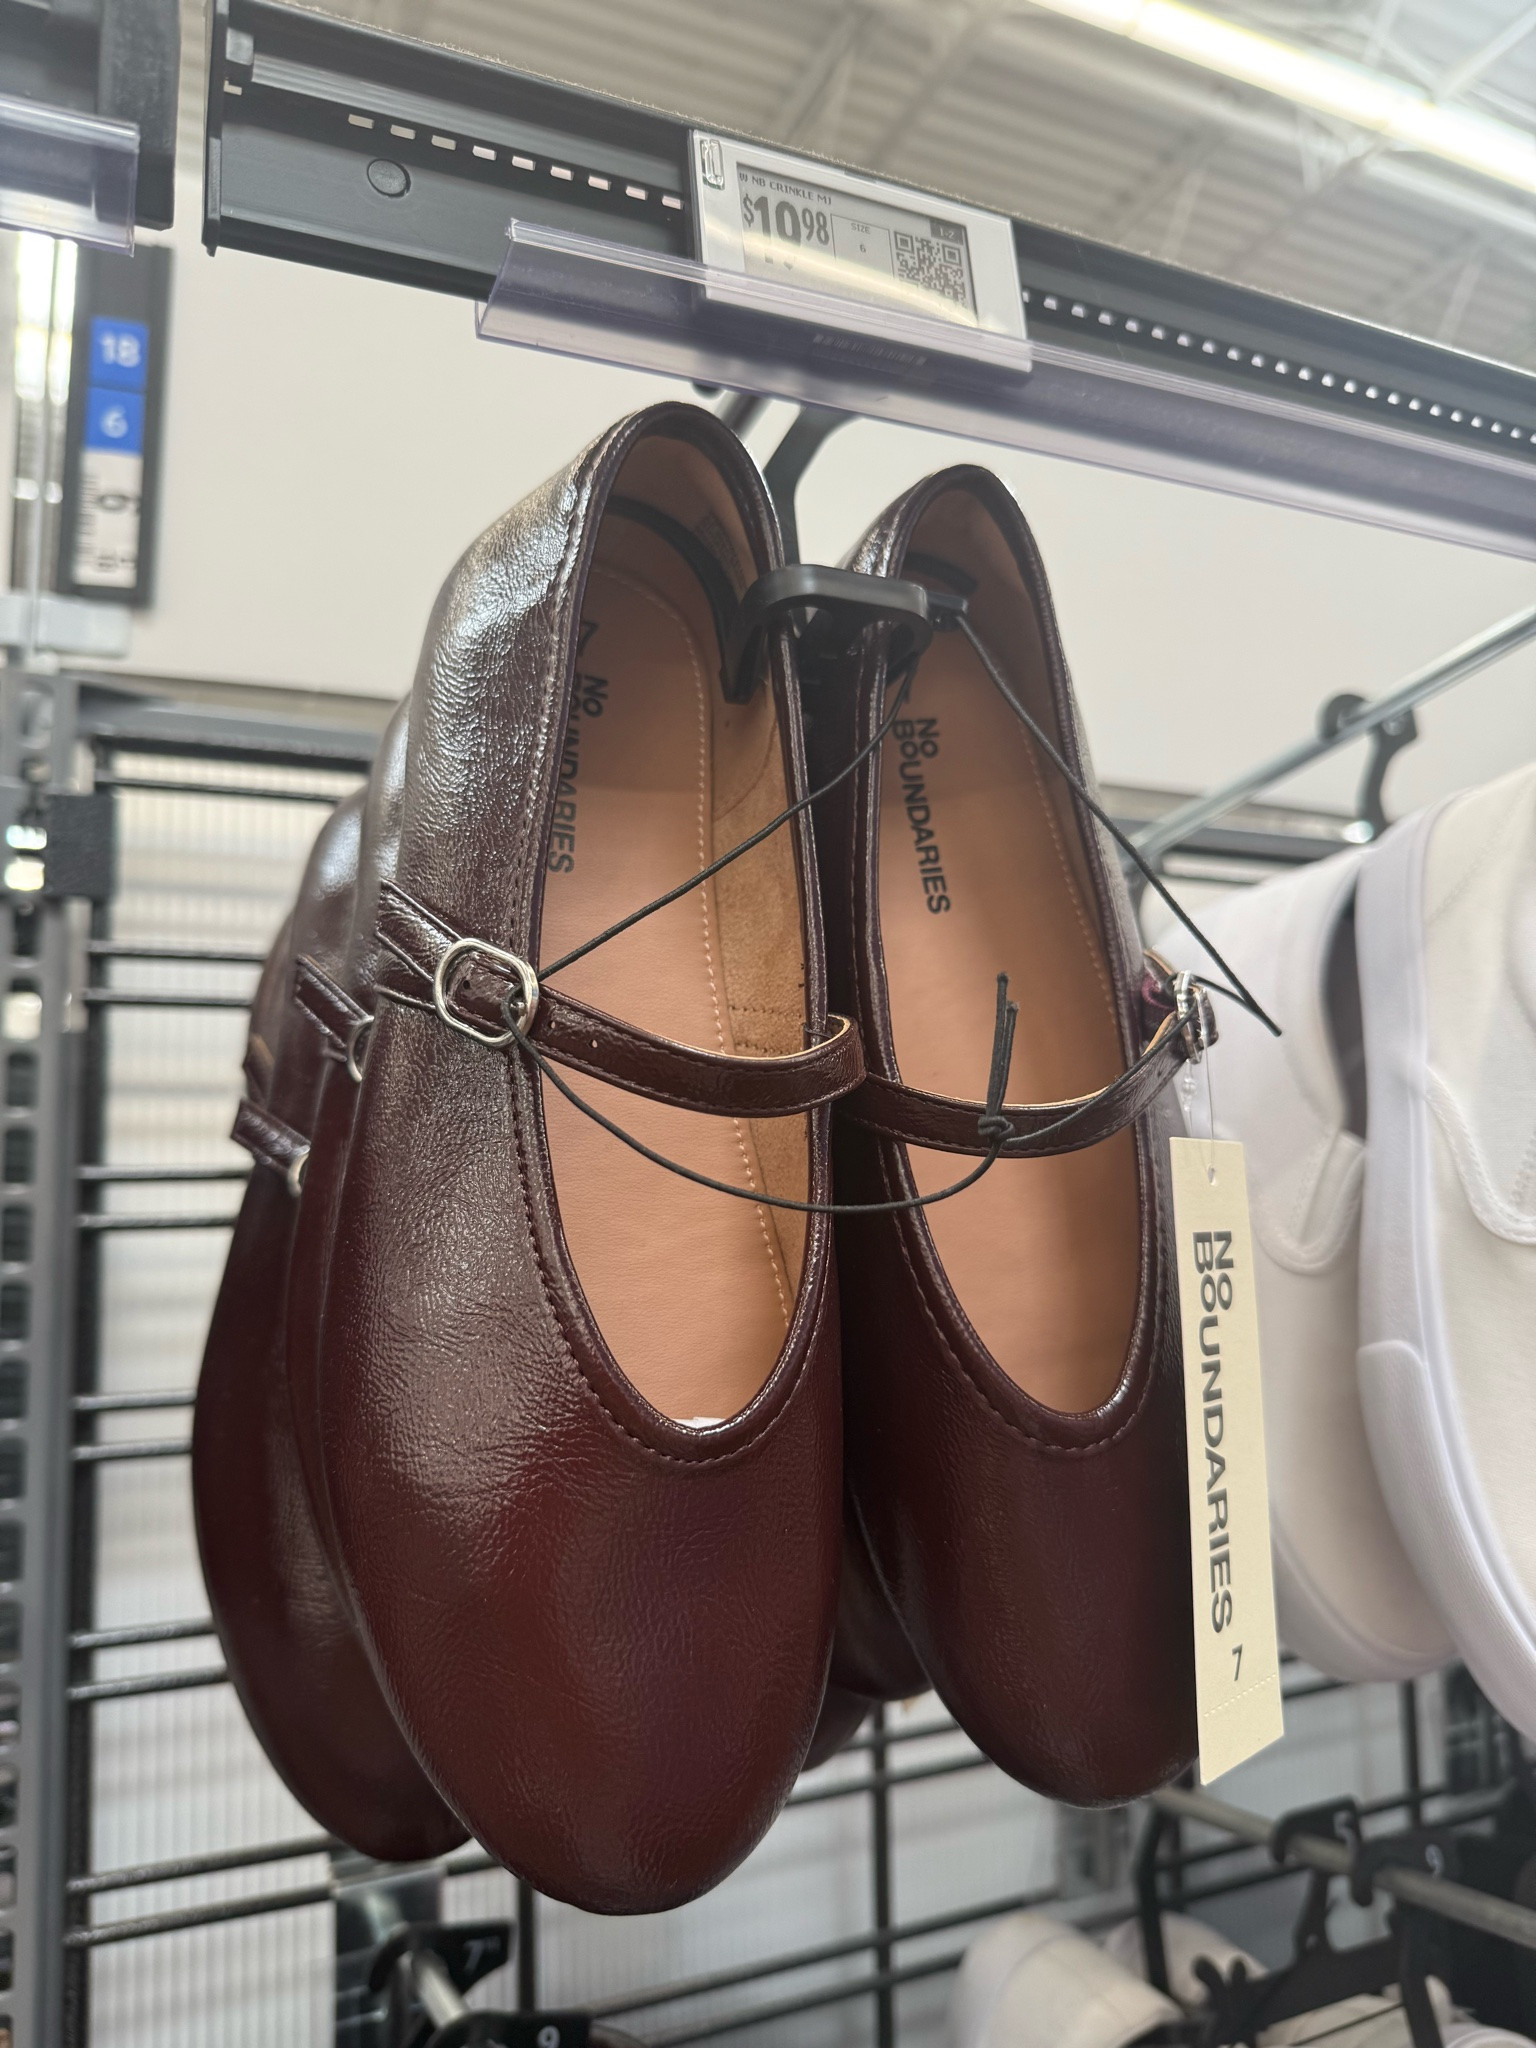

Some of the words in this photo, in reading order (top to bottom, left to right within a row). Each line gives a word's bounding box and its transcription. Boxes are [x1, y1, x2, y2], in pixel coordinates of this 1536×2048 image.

[752, 175, 766, 187] NB
[769, 181, 814, 201] CRINKLE
[850, 222, 871, 235] SIZE
[859, 243, 866, 253] 6
[100, 331, 141, 368] 18
[101, 404, 129, 438] 6
[582, 674, 608, 718] NO
[916, 718, 940, 759] NO
[892, 718, 951, 915] BOUNDARIES
[1213, 1230, 1234, 1311] NO
[1192, 1231, 1233, 1633] BOUNDARIES
[1232, 1644, 1243, 1682] 7
